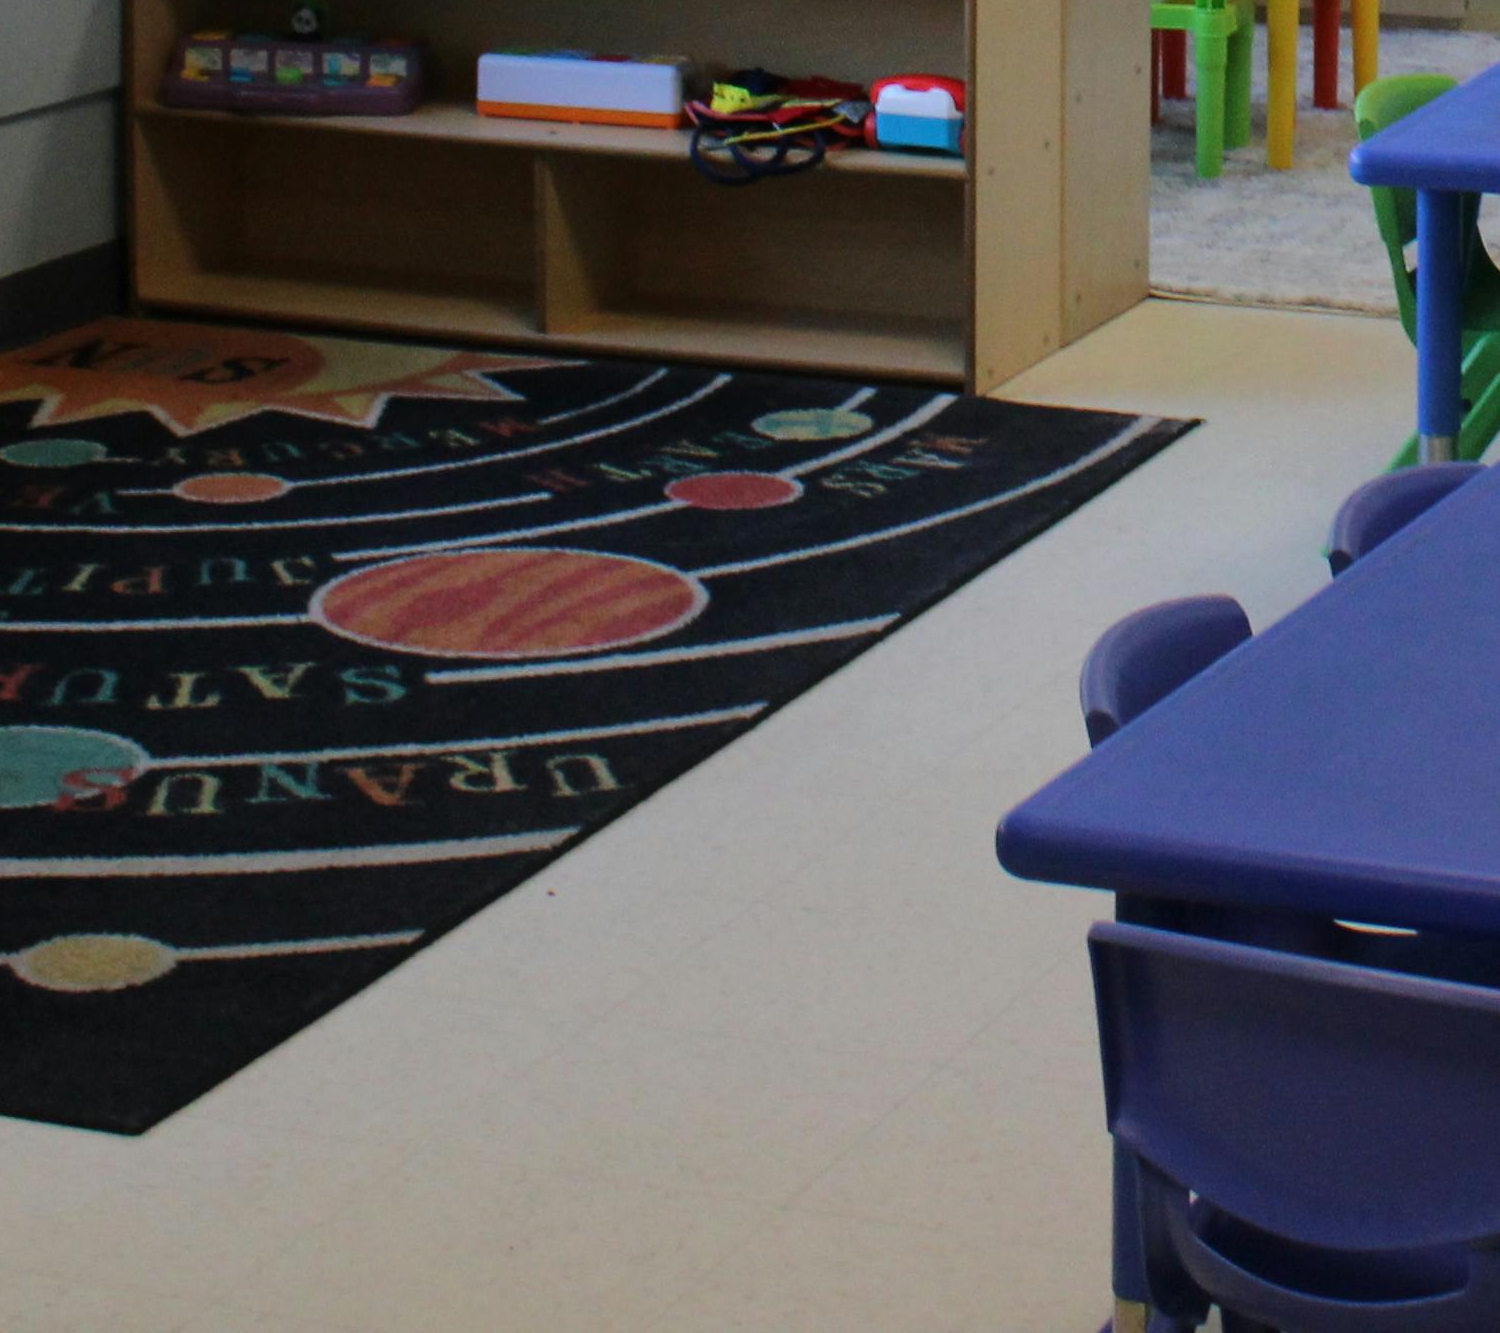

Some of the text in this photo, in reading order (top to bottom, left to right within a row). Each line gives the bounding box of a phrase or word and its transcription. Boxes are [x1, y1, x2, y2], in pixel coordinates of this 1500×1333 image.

[32, 335, 294, 385] SUN
[148, 416, 538, 467] MERCURY
[816, 432, 988, 498] MARS
[53, 753, 623, 816] URANUS
